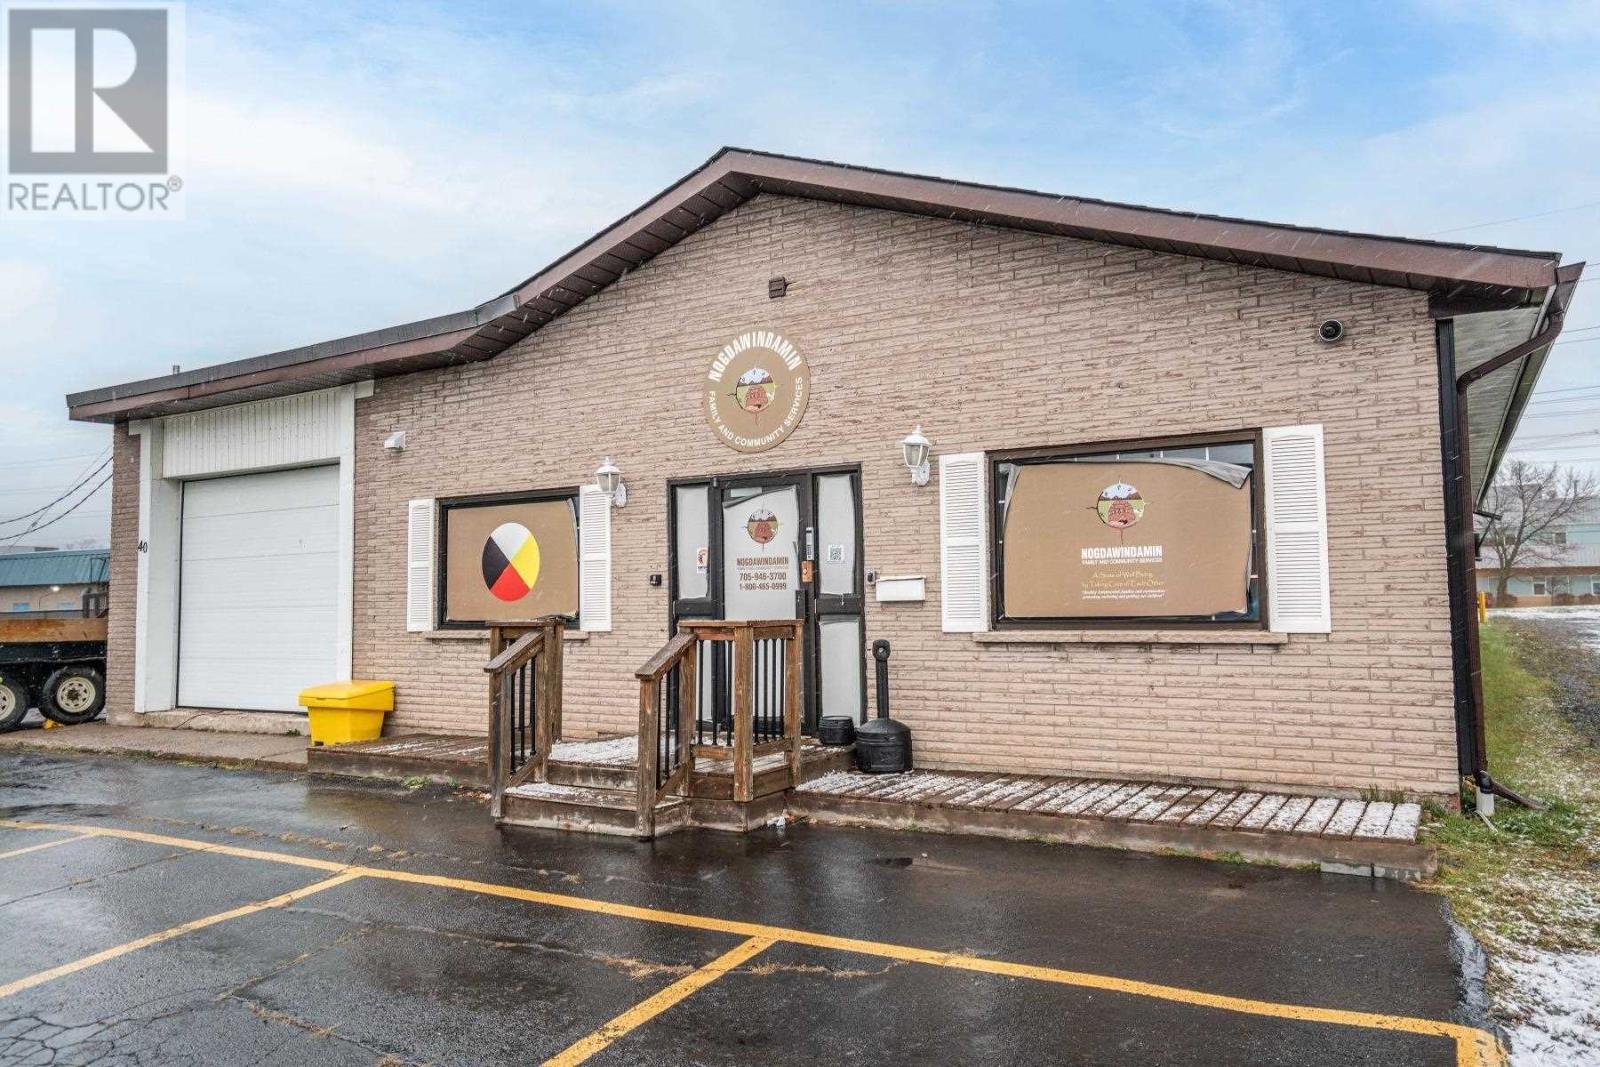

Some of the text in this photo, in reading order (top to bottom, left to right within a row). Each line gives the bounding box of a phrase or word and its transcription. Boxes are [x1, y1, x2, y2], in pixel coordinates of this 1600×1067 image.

[708, 330, 803, 382] NOGDAWINDAMIN
[709, 376, 803, 447] FAMILY AND COMMUNITY SERVICES
[137, 540, 148, 554] 40
[1081, 545, 1163, 559] NOGDAWINDAMIN
[736, 556, 789, 567] NOGDAWINDAMIN
[740, 572, 787, 581] 705-946-3700
